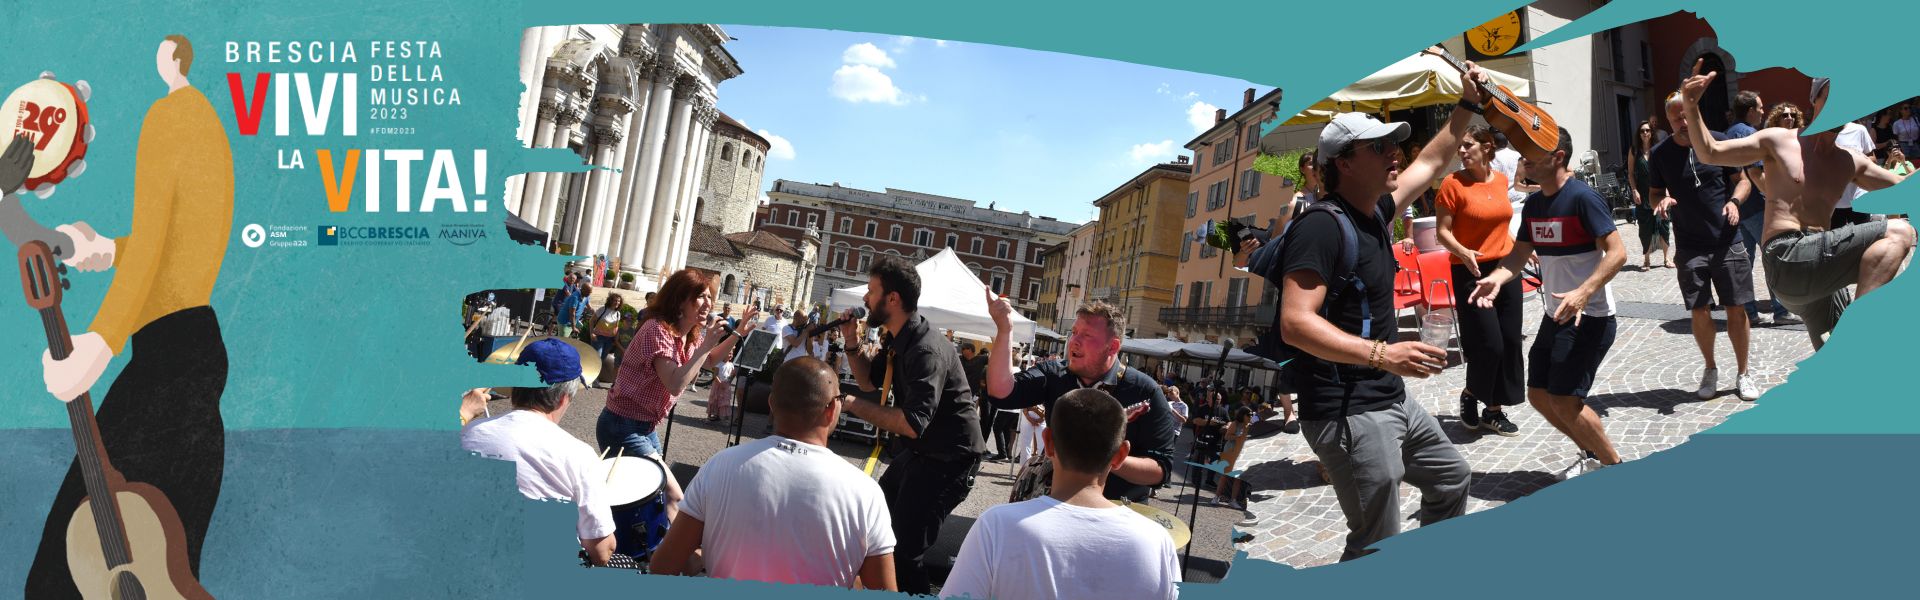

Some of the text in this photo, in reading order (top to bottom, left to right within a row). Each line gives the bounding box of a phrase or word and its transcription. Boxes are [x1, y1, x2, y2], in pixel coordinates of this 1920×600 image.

[225, 41, 358, 63] BRESCIA
[370, 40, 442, 58] FESTA
[370, 64, 443, 82] DELLA
[226, 72, 358, 136] VIVI
[370, 87, 461, 106] MUSICA
[370, 107, 408, 120] 2023
[370, 127, 415, 135] #FDM2023
[278, 148, 488, 212] LA VITA!
[269, 224, 307, 232] Fondazione
[438, 228, 487, 239] MANIVA
[1536, 226, 1555, 238] FILA
